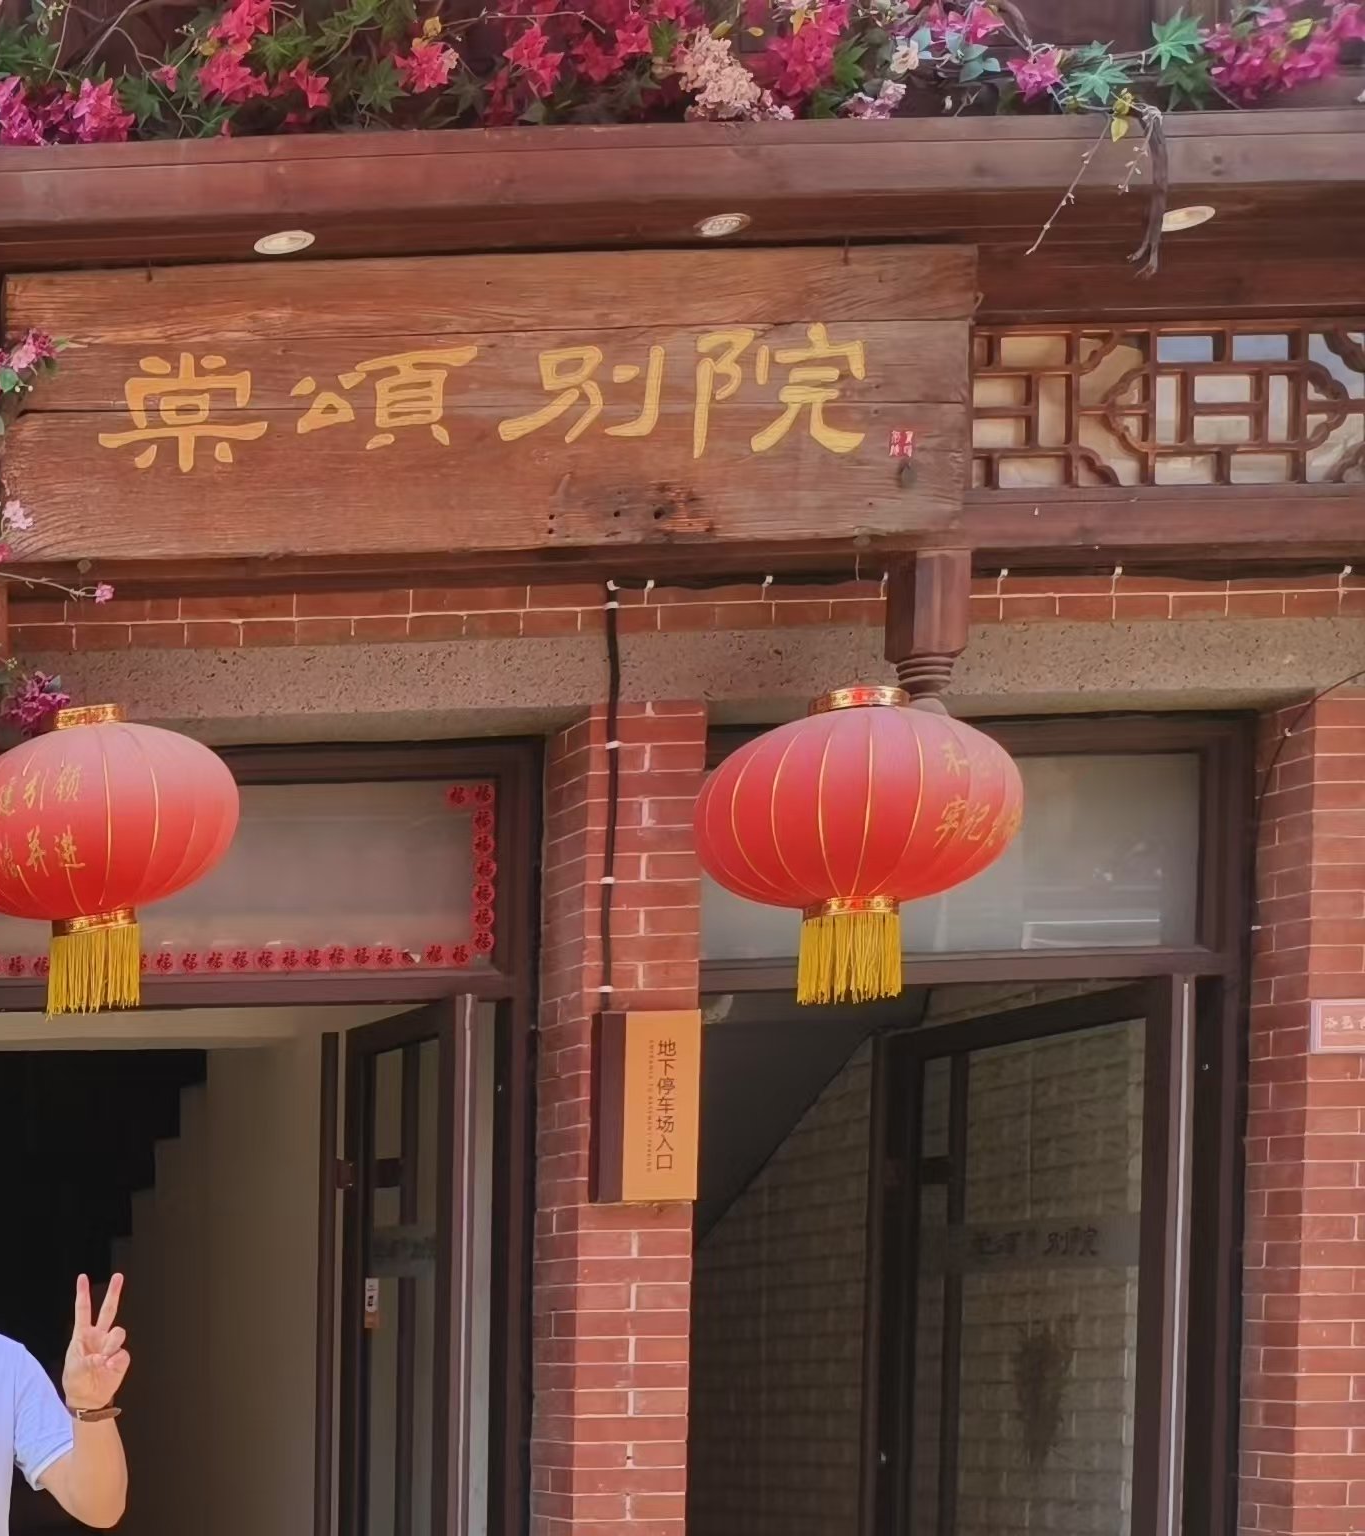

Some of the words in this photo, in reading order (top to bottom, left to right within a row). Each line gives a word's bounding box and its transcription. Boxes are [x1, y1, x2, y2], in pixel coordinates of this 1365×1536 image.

[655, 1039, 677, 1170] 地下停车场入口
